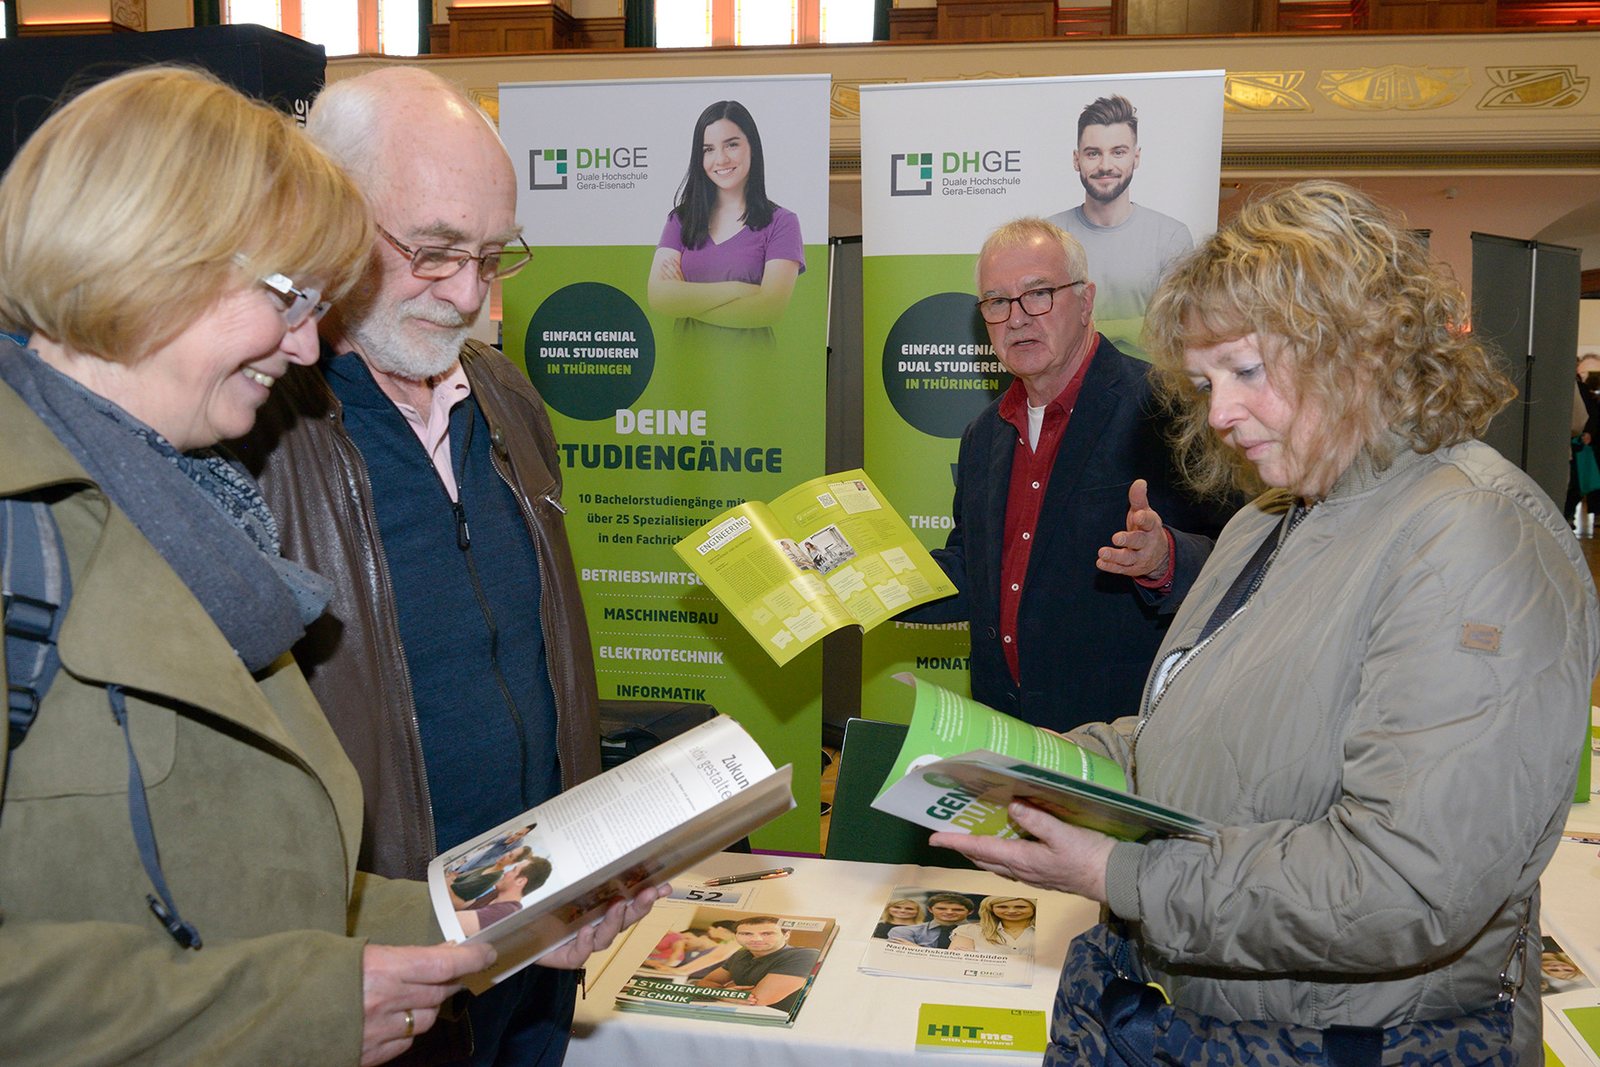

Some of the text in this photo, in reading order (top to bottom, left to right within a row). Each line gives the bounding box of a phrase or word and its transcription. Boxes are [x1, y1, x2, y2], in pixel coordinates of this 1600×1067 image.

[576, 147, 648, 169] DHGE
[942, 150, 1021, 173] DHGE
[577, 172, 648, 181] Duale Hochschule
[942, 176, 1021, 186] Duale Hochschule
[577, 181, 635, 190] Gera-Eisenach
[942, 186, 1007, 196] Gera-Eisenach
[542, 331, 636, 342] EINFACH GENIAL
[540, 347, 639, 358] DUAL STUDIEREN
[901, 344, 997, 355] EINFACH GENIA
[547, 361, 631, 375] IN THÜRINGEN
[898, 361, 1007, 373] DUAL STUDIEREN
[905, 376, 999, 390] IN THÜRINGEN
[615, 408, 707, 436] DEINE
[578, 494, 591, 504] 10
[595, 494, 723, 510] Bachelorstudiengänge
[587, 513, 612, 524] über
[616, 514, 630, 524] 25
[598, 533, 684, 546] in den Fachrich
[699, 517, 749, 554] ENGINEERING
[581, 568, 704, 586] BETRIEBSWIRTSC
[604, 607, 719, 625] MASCHINENBAU
[599, 646, 724, 664] ELEKTROTECHNIK
[916, 656, 971, 671] MONAT
[616, 684, 706, 701] INFORMATIK
[721, 754, 750, 789] Zukun
[697, 758, 732, 800] gestalte
[685, 889, 723, 902] 52
[886, 943, 1008, 961] Nachwuchskräfte ausbilden
[632, 989, 689, 1003] TECHNIK
[638, 980, 747, 999] STUDIENFÜHRER
